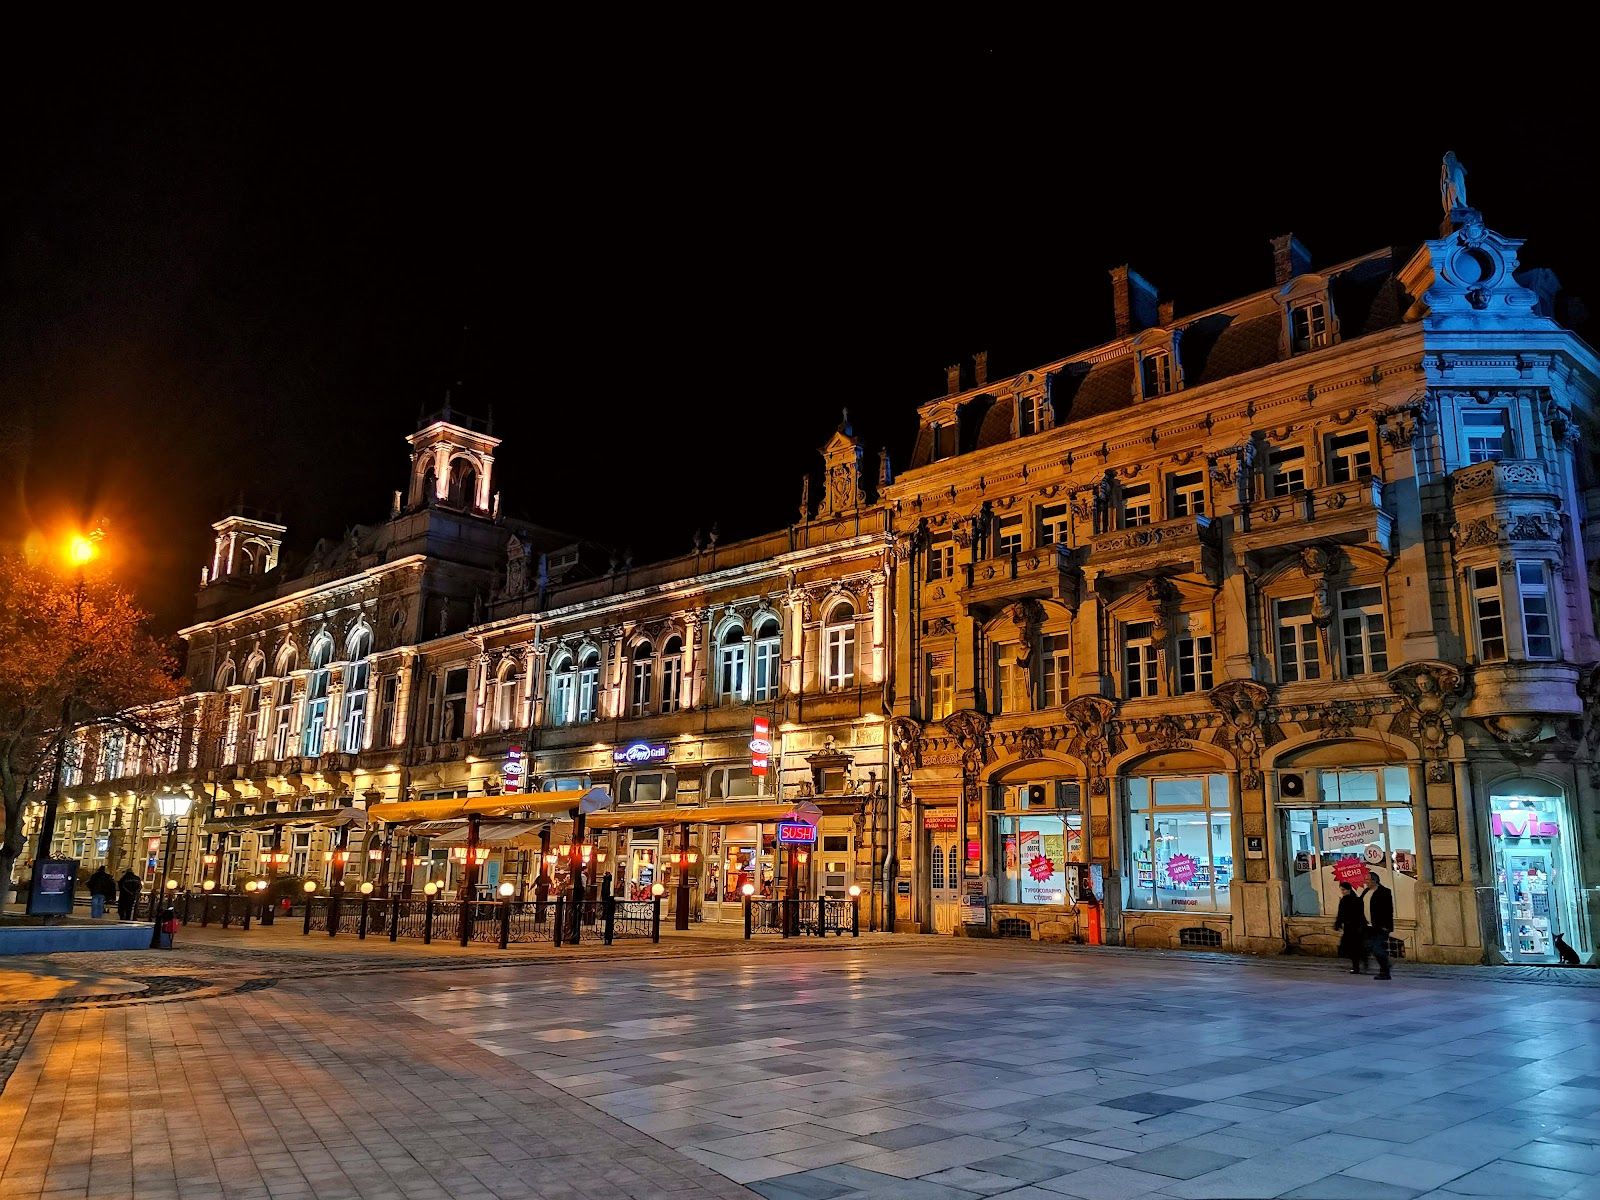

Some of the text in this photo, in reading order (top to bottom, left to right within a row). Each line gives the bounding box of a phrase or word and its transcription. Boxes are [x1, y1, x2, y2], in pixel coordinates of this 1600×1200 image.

[614, 752, 627, 760] Bar
[651, 747, 666, 757] Grill
[782, 826, 815, 840] SUSHI
[1332, 824, 1357, 834] НОВО
[1173, 864, 1191, 873] цена
[1341, 868, 1362, 878] цена
